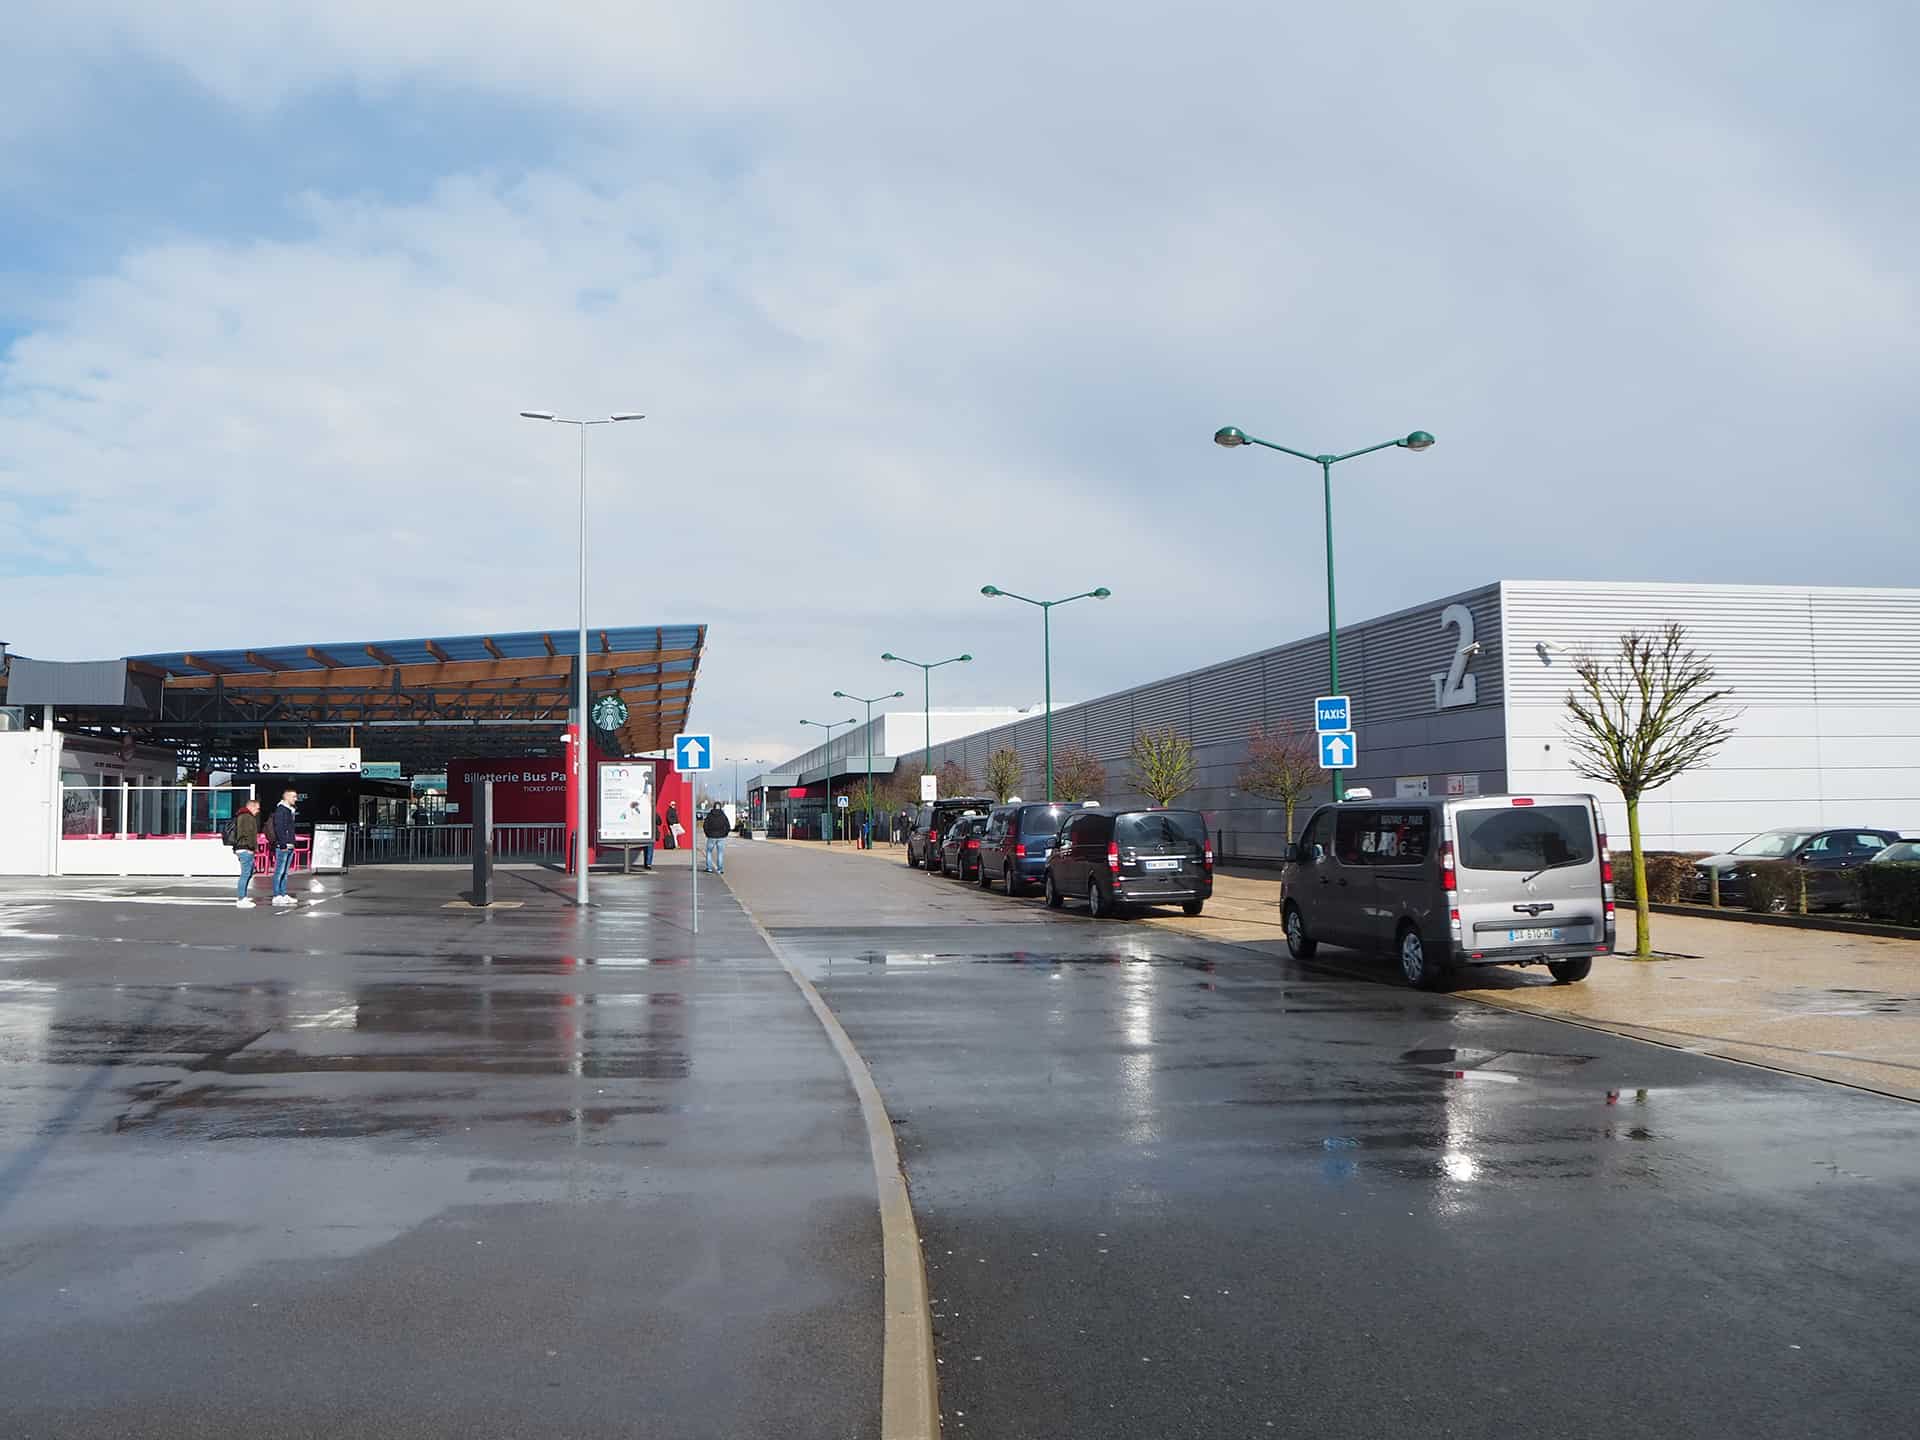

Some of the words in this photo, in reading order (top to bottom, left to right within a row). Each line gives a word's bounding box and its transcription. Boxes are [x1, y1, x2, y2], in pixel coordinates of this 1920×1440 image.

[1319, 709, 1346, 720] TAXIS
[464, 772, 519, 783] Billetterie
[523, 772, 547, 782] Bus
[551, 771, 567, 782] Pa
